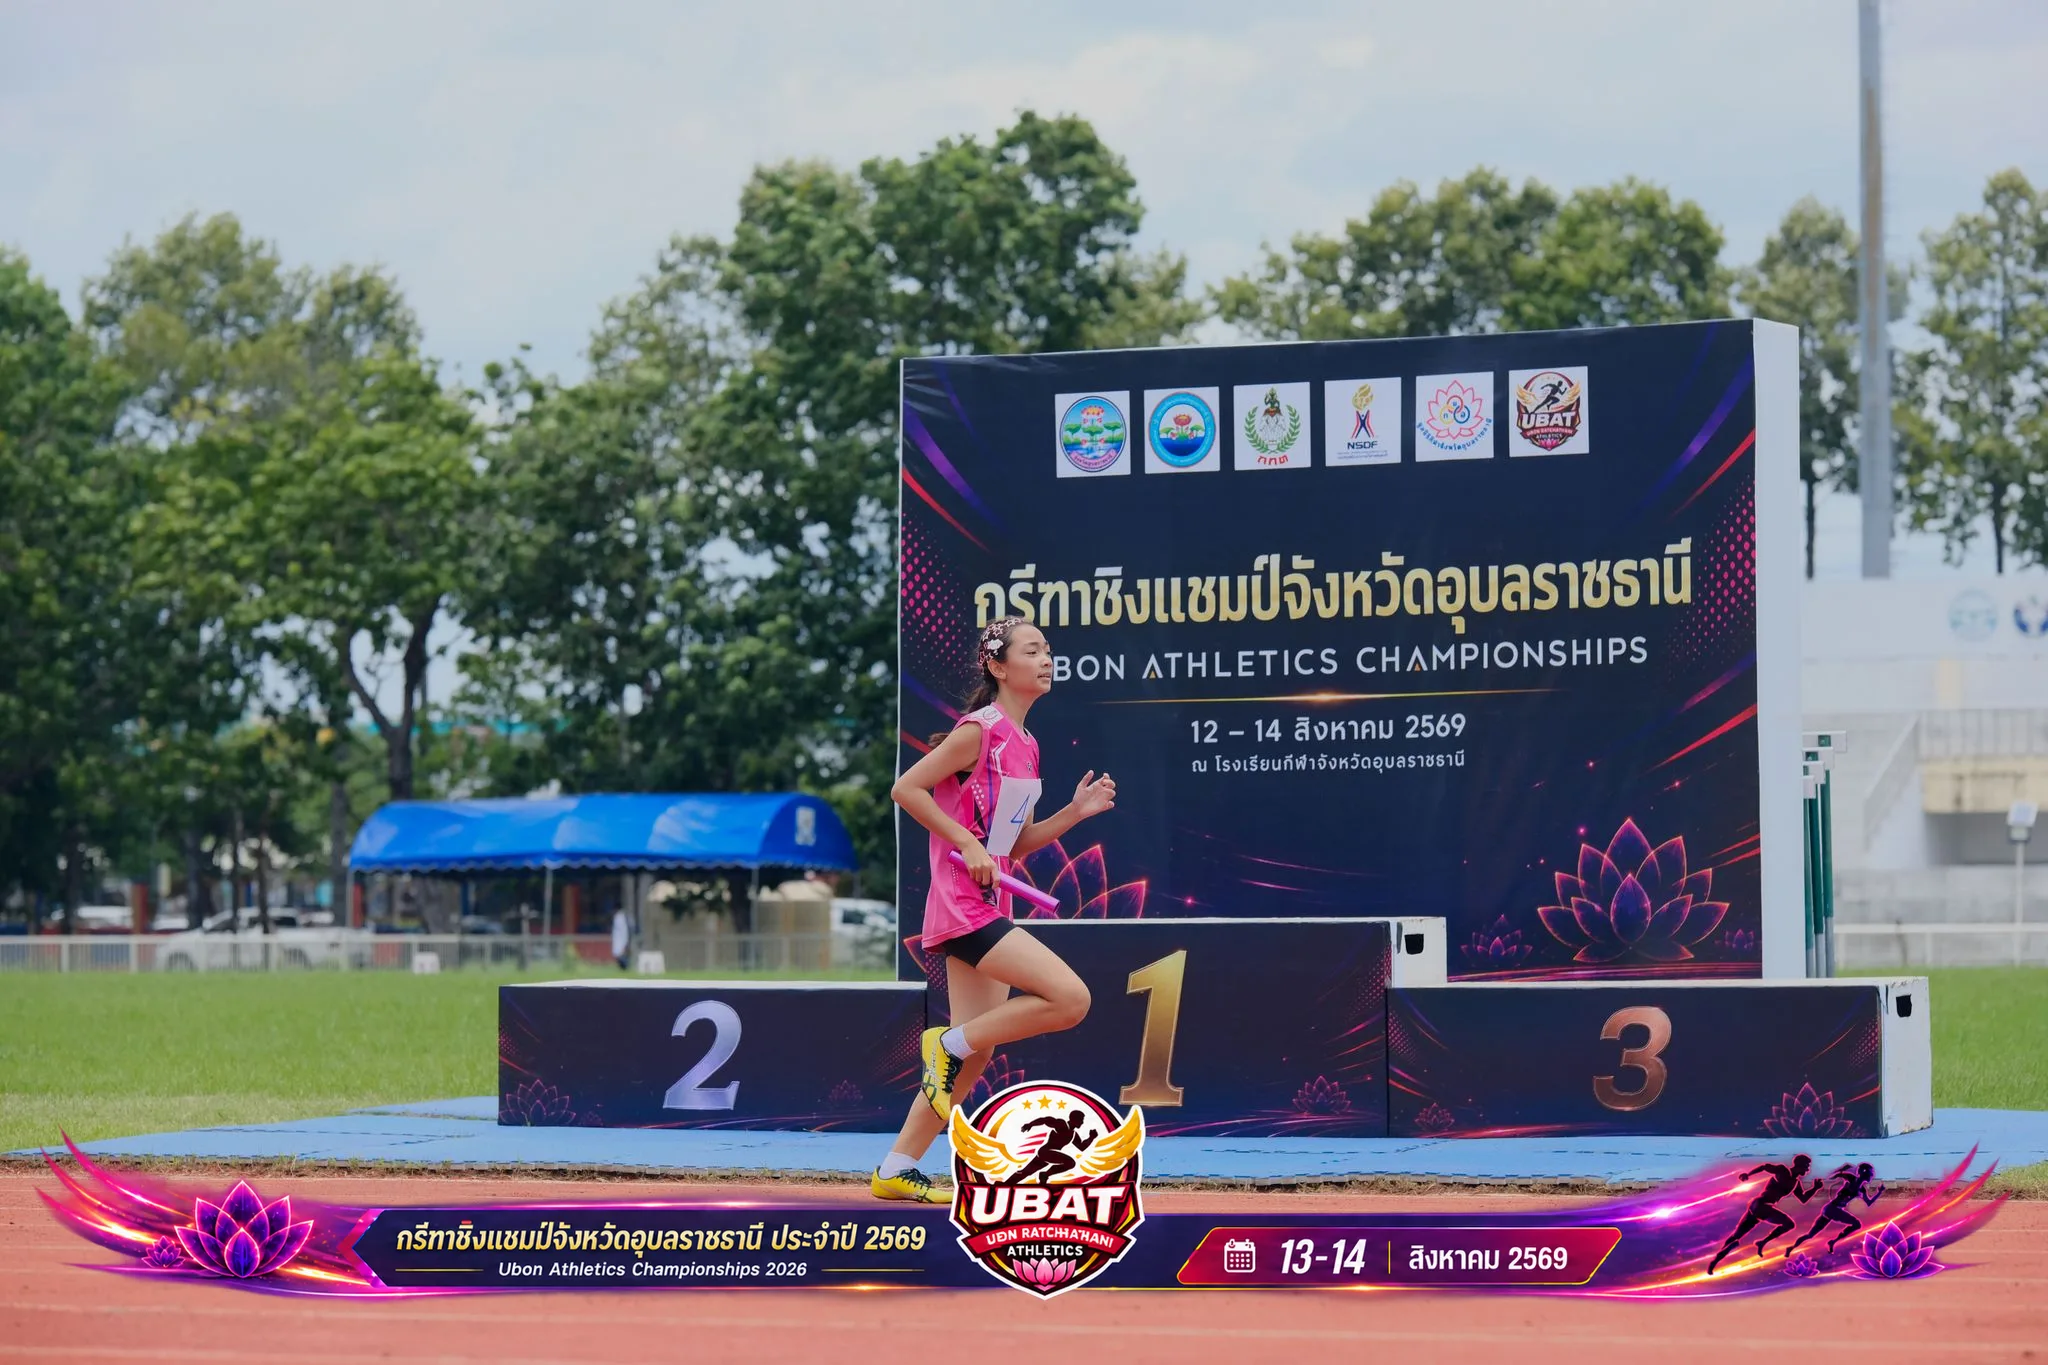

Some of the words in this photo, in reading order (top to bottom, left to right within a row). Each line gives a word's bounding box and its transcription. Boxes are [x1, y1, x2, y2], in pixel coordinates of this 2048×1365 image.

[1521, 411, 1577, 430] UBAT
[1347, 440, 1378, 450] NSDF
[1053, 654, 1125, 682] BON
[1142, 648, 1338, 681] ATHLETICS
[1356, 636, 1648, 674] CHAMPIONSHIPS
[1191, 719, 1219, 744] 12
[1254, 718, 1282, 743] 14
[1294, 716, 1394, 742] สิงหาคม
[1404, 713, 1466, 739] 2569
[1192, 760, 1207, 773] ณ
[1214, 749, 1466, 774] โรงเรียนกีฬาจังหวัดอุบลราชธานี
[1009, 792, 1031, 839] 4
[1119, 949, 1188, 1107] 1
[664, 1000, 742, 1111] 2
[1592, 1006, 1672, 1111] 3
